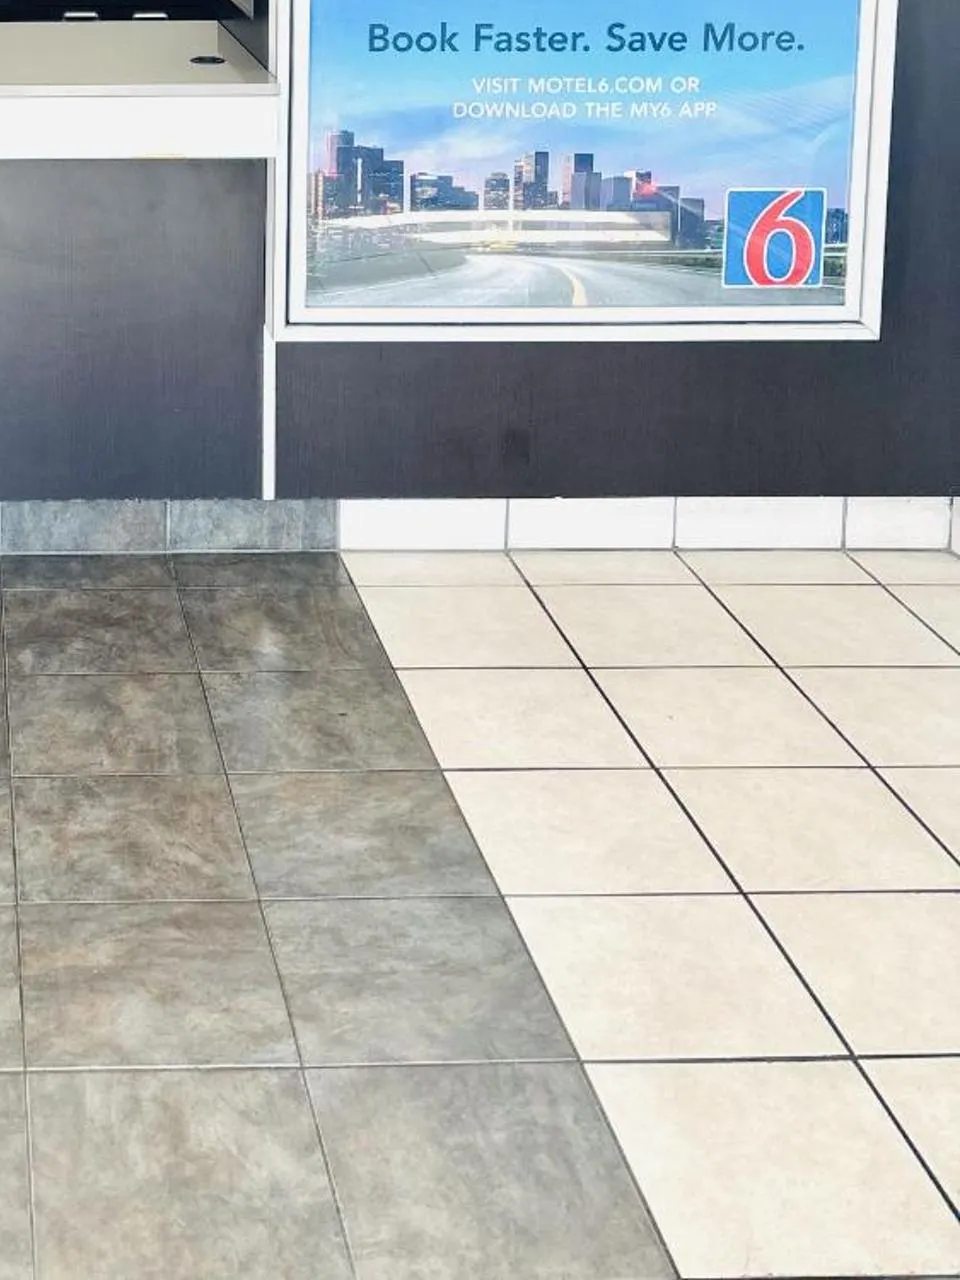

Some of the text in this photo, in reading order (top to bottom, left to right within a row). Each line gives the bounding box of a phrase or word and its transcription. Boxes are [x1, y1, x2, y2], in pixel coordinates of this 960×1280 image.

[368, 21, 805, 53] Book Faster. Save More.
[472, 76, 700, 94] VISIT MOTEL6.COM OR
[452, 101, 718, 119] DOWNLOAD THE MY6 APP
[743, 188, 816, 288] 6
